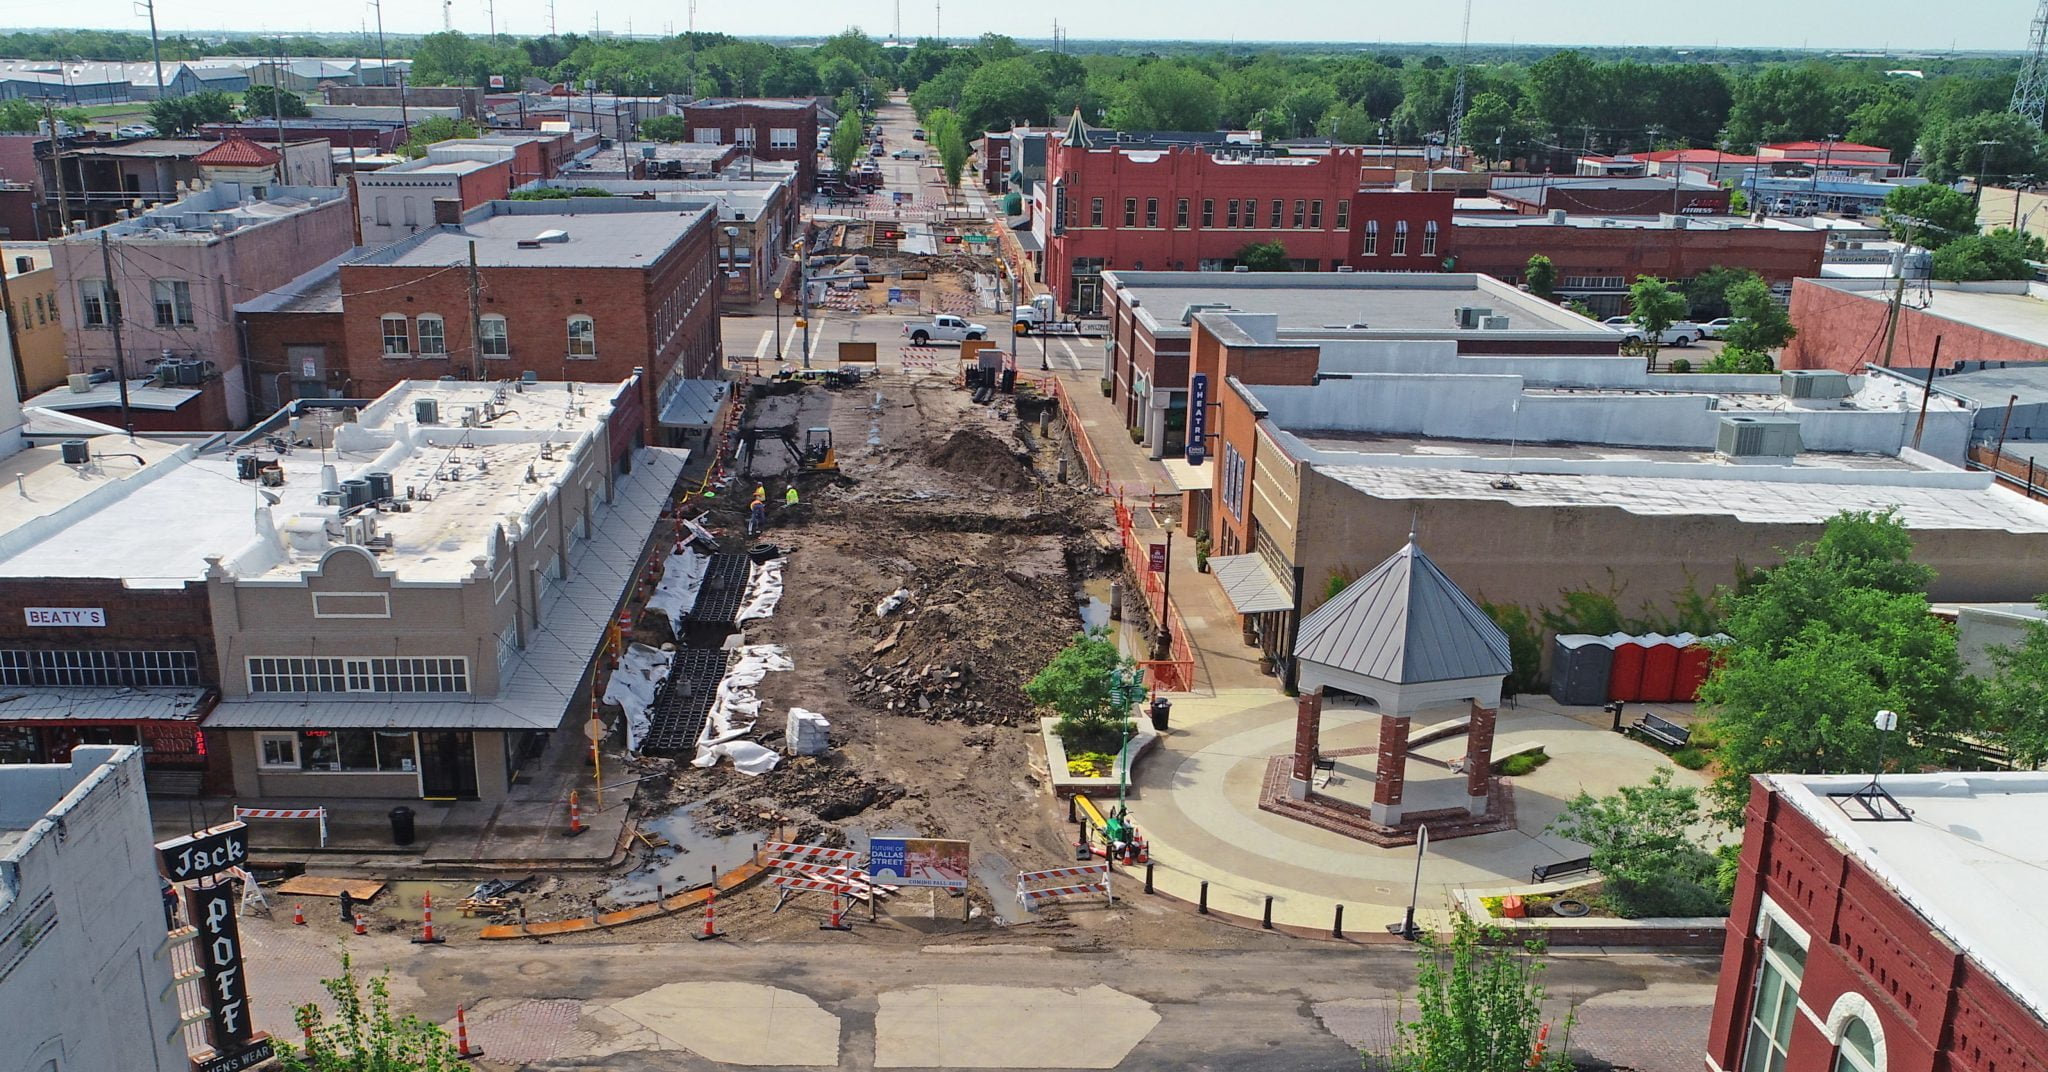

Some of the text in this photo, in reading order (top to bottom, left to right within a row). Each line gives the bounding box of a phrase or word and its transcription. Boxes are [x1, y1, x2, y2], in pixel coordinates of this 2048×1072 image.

[1194, 382, 1204, 443] THEATRE
[29, 610, 101, 624] BEATY'S
[156, 738, 193, 753] SHOP
[195, 731, 207, 755] OPEN
[174, 835, 245, 877] Jack
[871, 850, 904, 858] DALLAS
[871, 857, 904, 865] STREET
[205, 897, 242, 1034] POFF
[241, 1046, 269, 1065] WEAR
